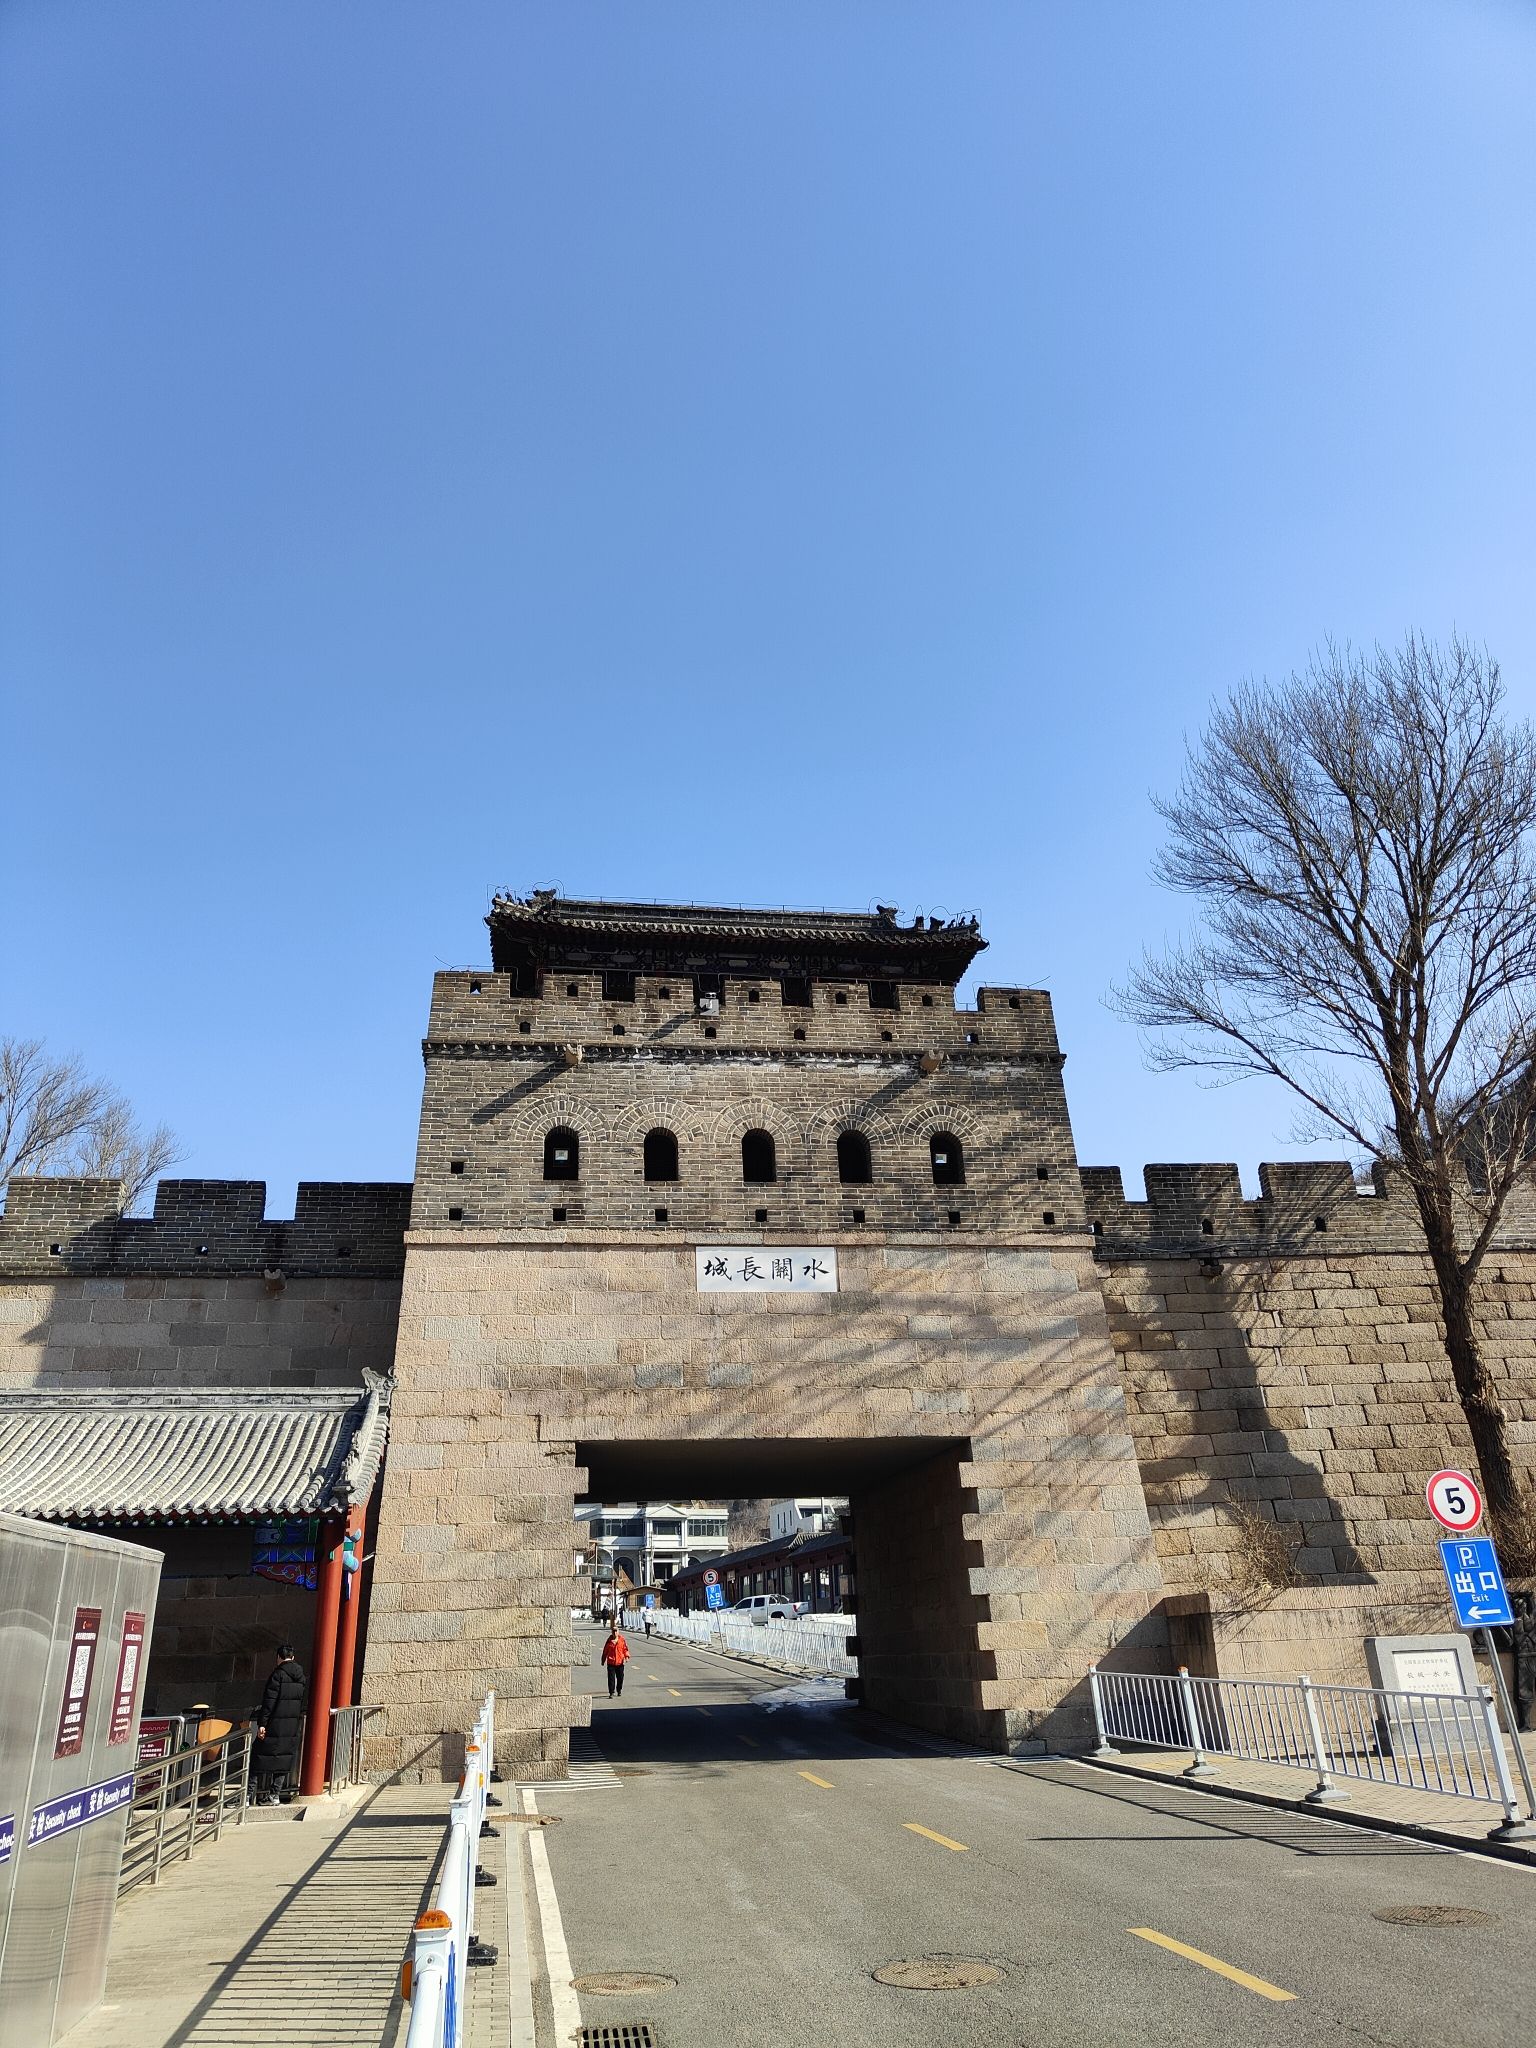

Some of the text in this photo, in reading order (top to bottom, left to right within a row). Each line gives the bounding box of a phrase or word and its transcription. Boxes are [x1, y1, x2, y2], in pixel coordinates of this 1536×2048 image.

[1444, 1487, 1466, 1515] 5
[1459, 1547, 1473, 1567] P
[708, 1573, 714, 1582] 5
[1454, 1571, 1498, 1594] 出口
[1471, 1594, 1490, 1603] Exit
[103, 1787, 120, 1806] Security
[120, 1783, 130, 1799] check
[45, 1808, 67, 1831] Security
[67, 1802, 82, 1821] check
